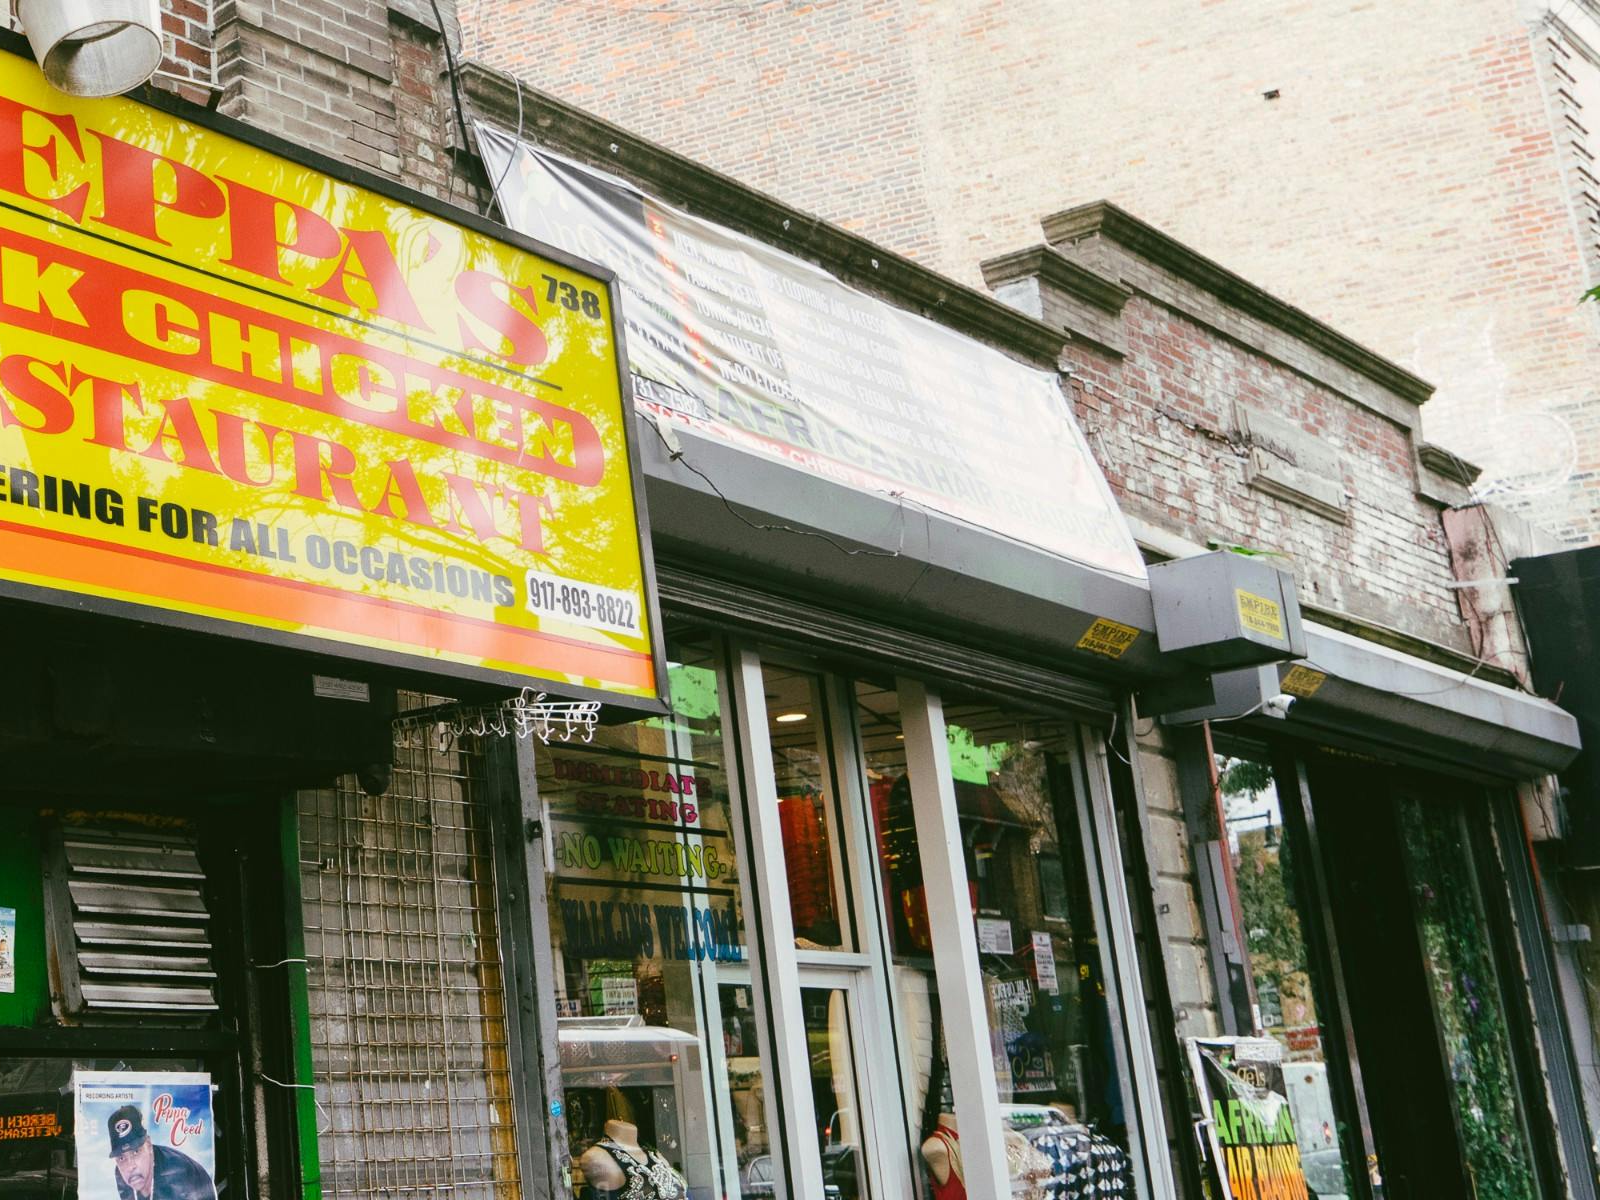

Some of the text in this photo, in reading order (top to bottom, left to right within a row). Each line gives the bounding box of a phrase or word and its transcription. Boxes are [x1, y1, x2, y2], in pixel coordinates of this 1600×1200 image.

[540, 274, 602, 320] 738
[122, 288, 574, 470] CHICKEN
[137, 496, 218, 547] FOR
[229, 515, 297, 565] ALL
[305, 533, 516, 608] OCCASIONS
[529, 577, 636, 631] 917-893-8822
[553, 758, 713, 799] IMMEDIATE
[575, 791, 698, 823] SEATING
[653, 904, 742, 963] WELCOME
[85, 1092, 115, 1100] RECORDING
[152, 1093, 191, 1124] Peppa
[1221, 1146, 1261, 1200] AIR
